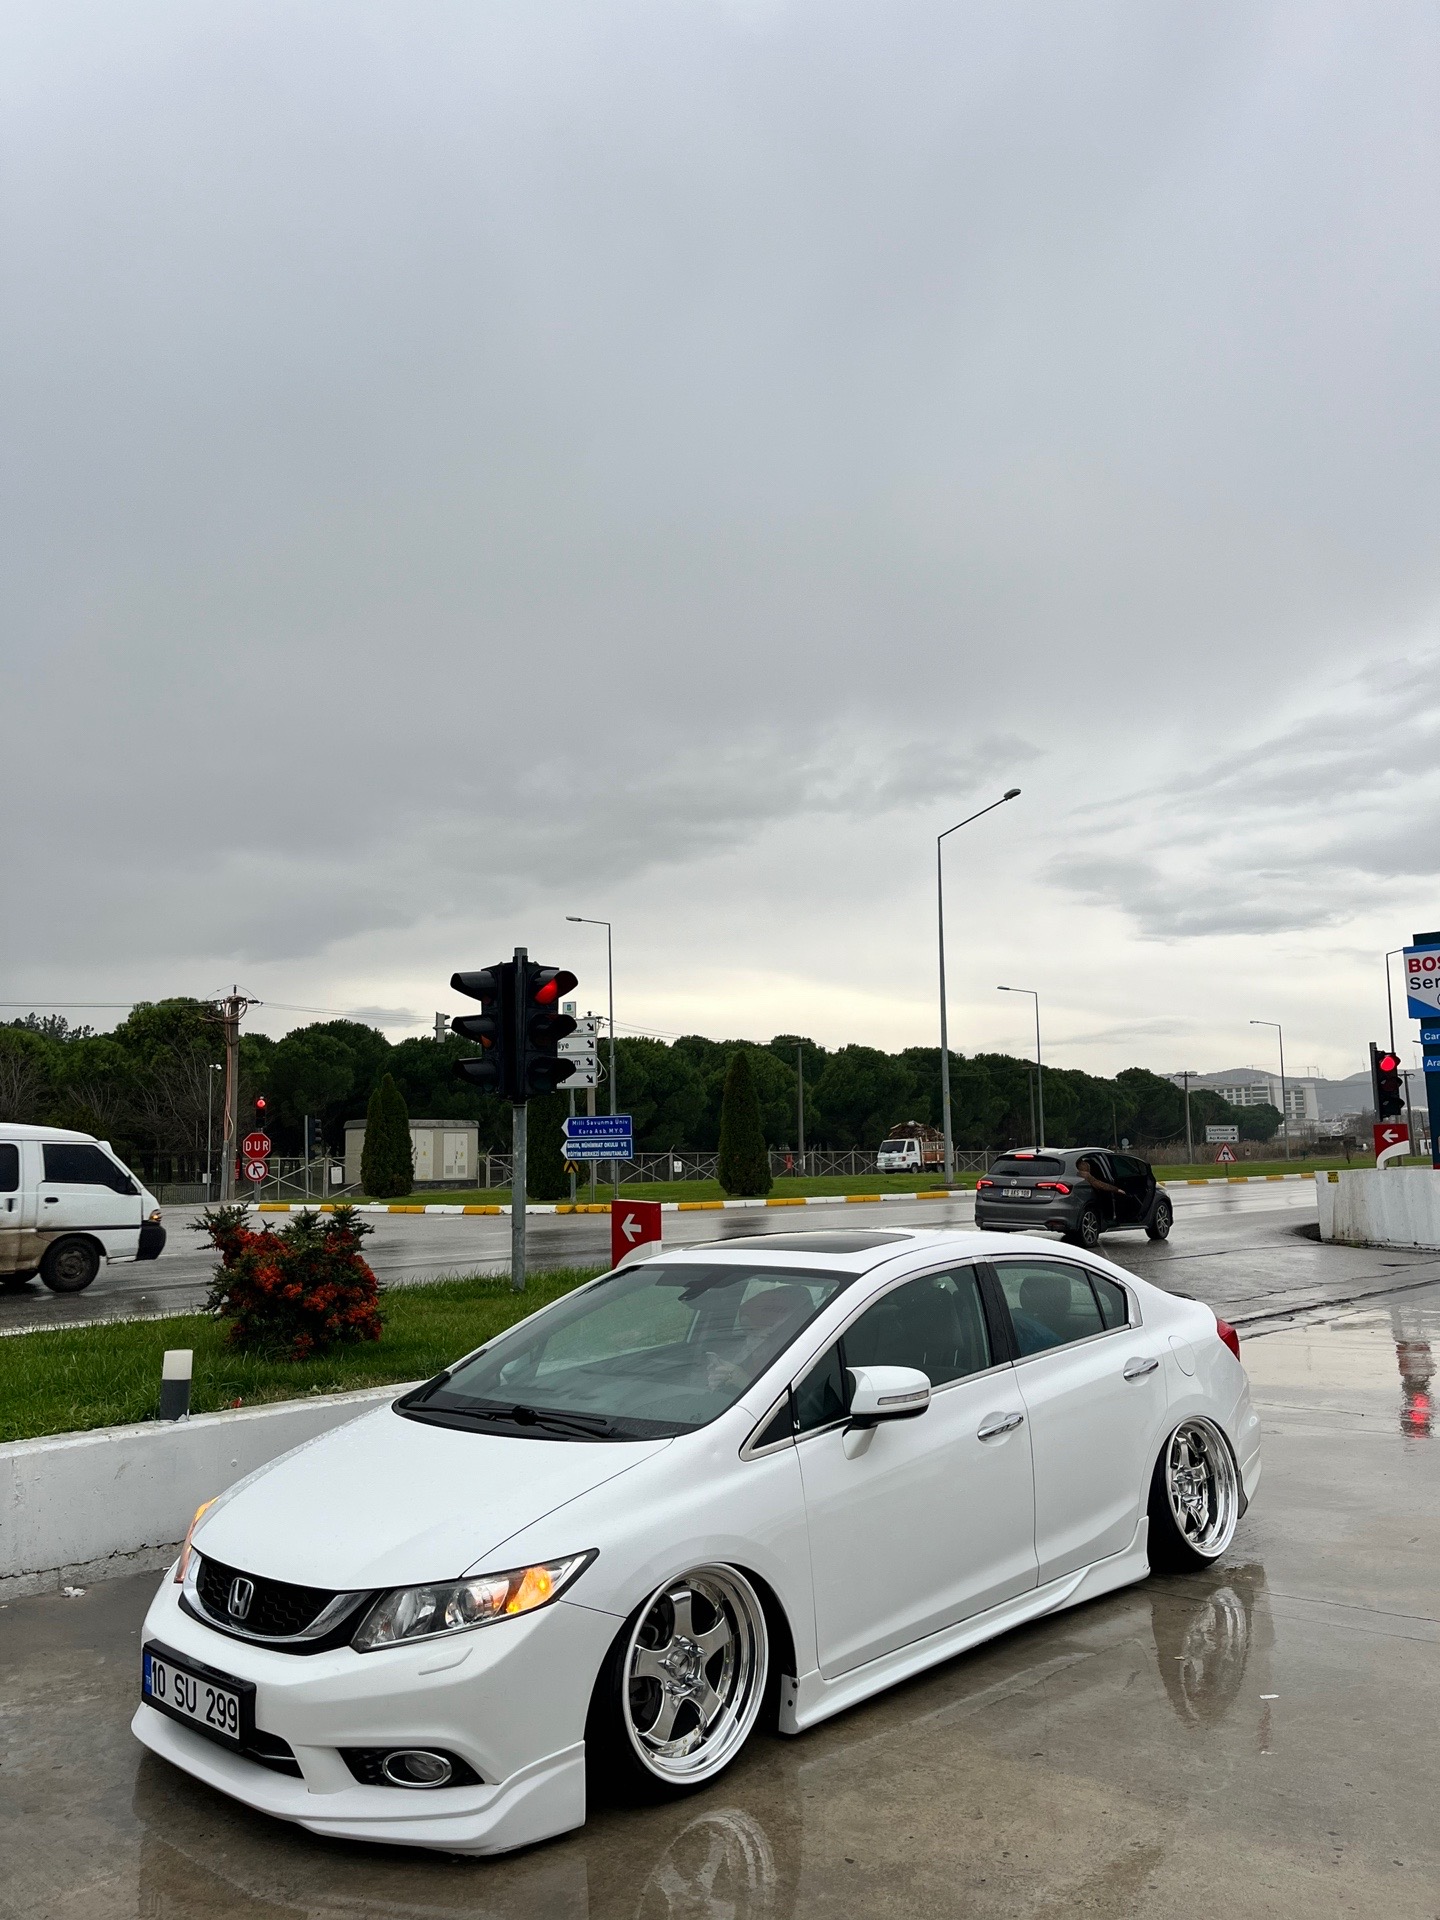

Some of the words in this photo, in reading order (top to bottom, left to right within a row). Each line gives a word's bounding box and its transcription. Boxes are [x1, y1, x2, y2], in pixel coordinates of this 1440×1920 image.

[1408, 956, 1440, 973] BO
[245, 1140, 269, 1151] DUR
[152, 1660, 166, 1698] 10
[174, 1673, 197, 1714] SU
[205, 1688, 238, 1733] 299
